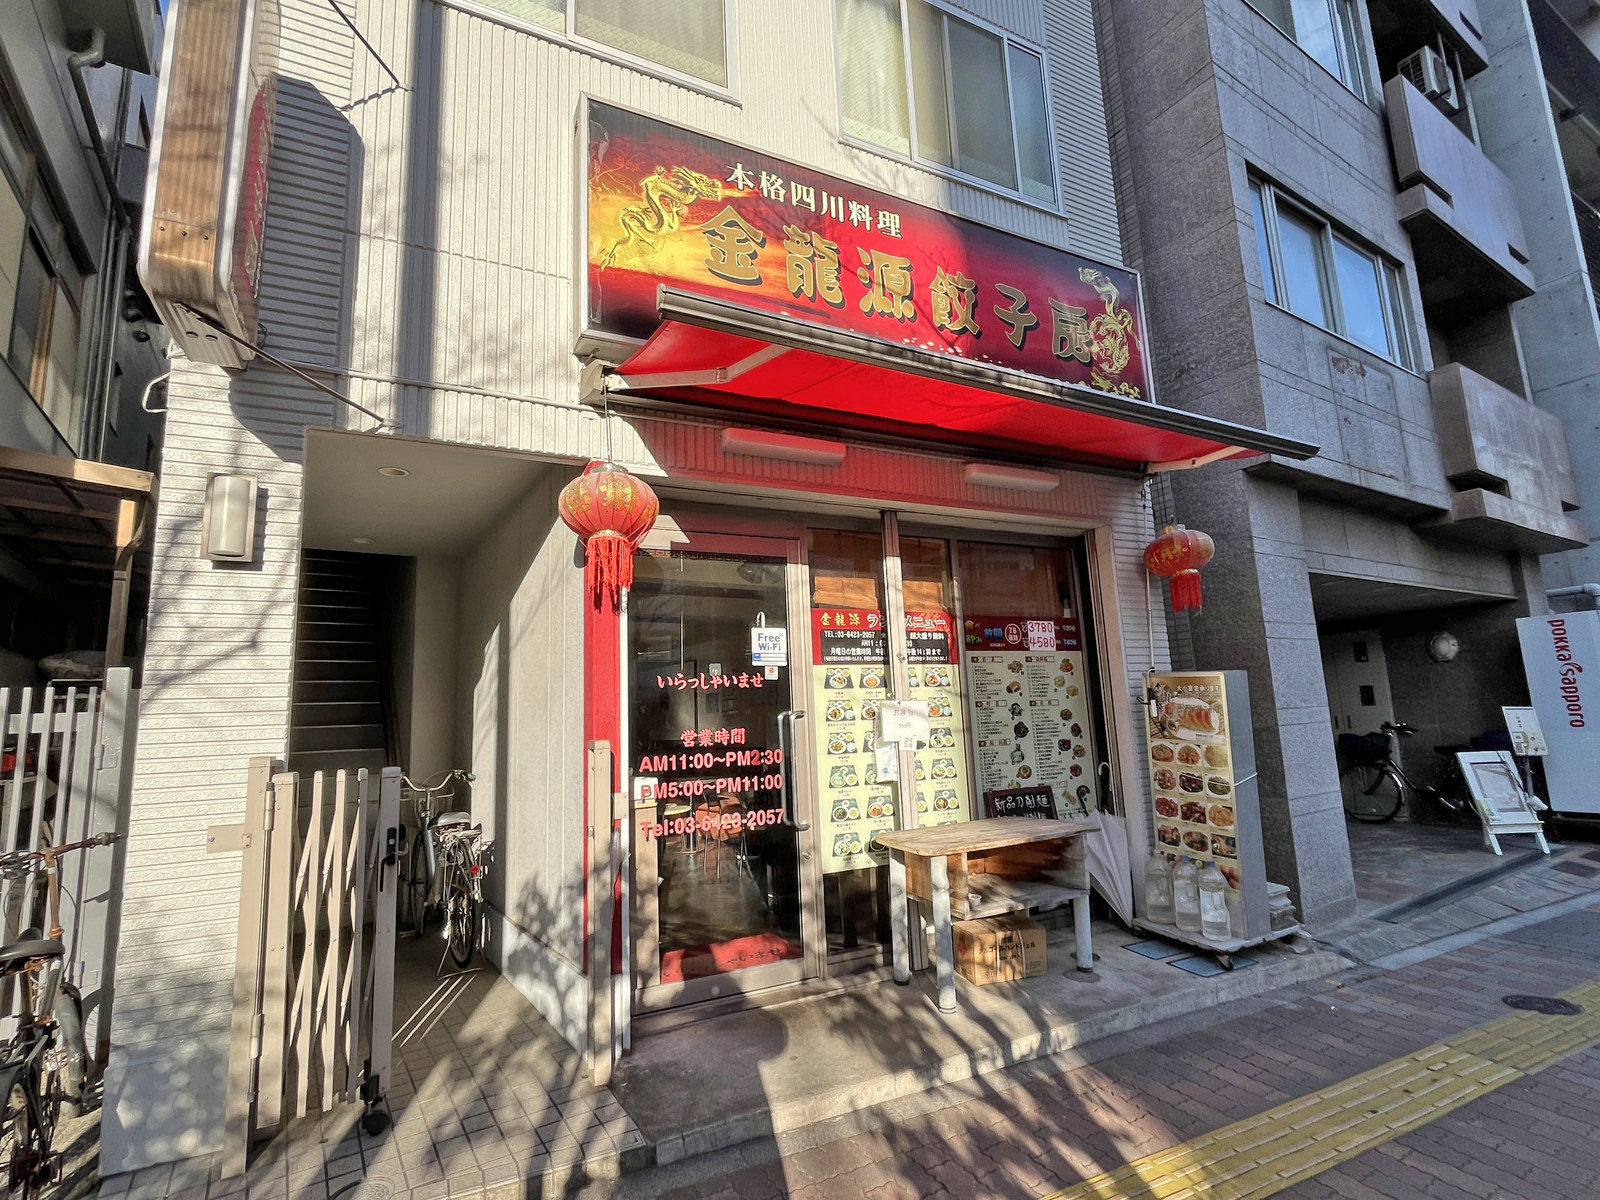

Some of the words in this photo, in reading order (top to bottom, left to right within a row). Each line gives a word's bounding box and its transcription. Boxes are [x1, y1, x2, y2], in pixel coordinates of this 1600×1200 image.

[725, 162, 902, 239] 本格四川料理
[820, 612, 861, 626] 金龍源
[866, 613, 948, 629] ランメニュー
[1028, 621, 1053, 633] 3780
[757, 632, 781, 642] Free
[1029, 636, 1055, 648] 4580
[757, 642, 781, 651] Wi-Fi
[656, 672, 764, 690] いらっしゃいませ
[680, 727, 746, 748] 営業時間
